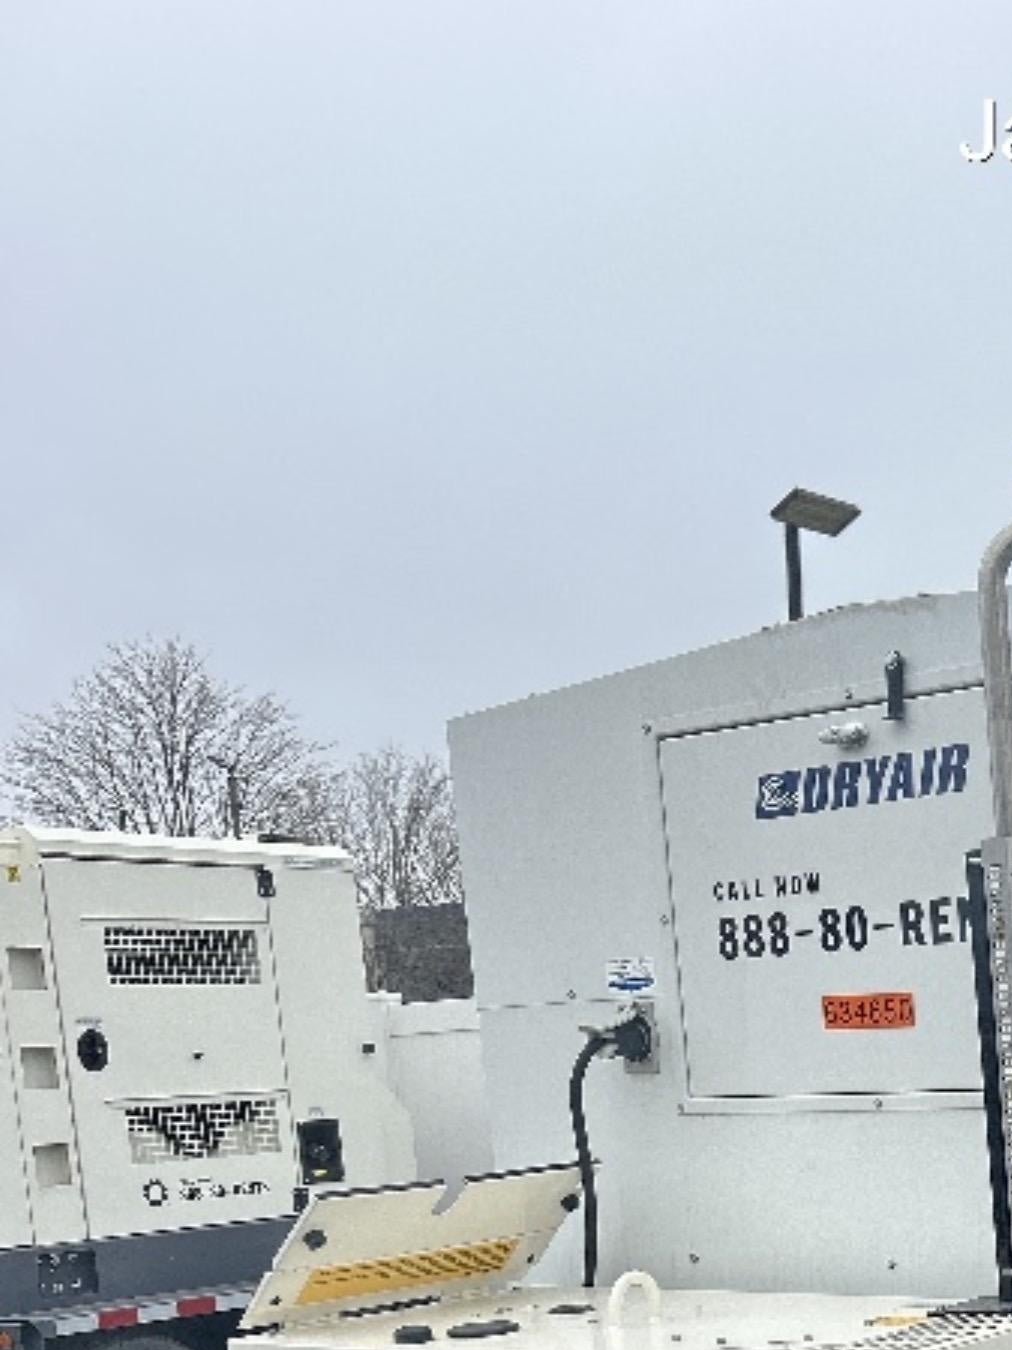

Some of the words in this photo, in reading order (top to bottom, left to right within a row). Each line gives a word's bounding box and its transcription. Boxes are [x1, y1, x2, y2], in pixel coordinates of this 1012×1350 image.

[801, 744, 970, 813] DRYAIR
[713, 879, 764, 901] CALL
[719, 896, 971, 960] 888-80-REN
